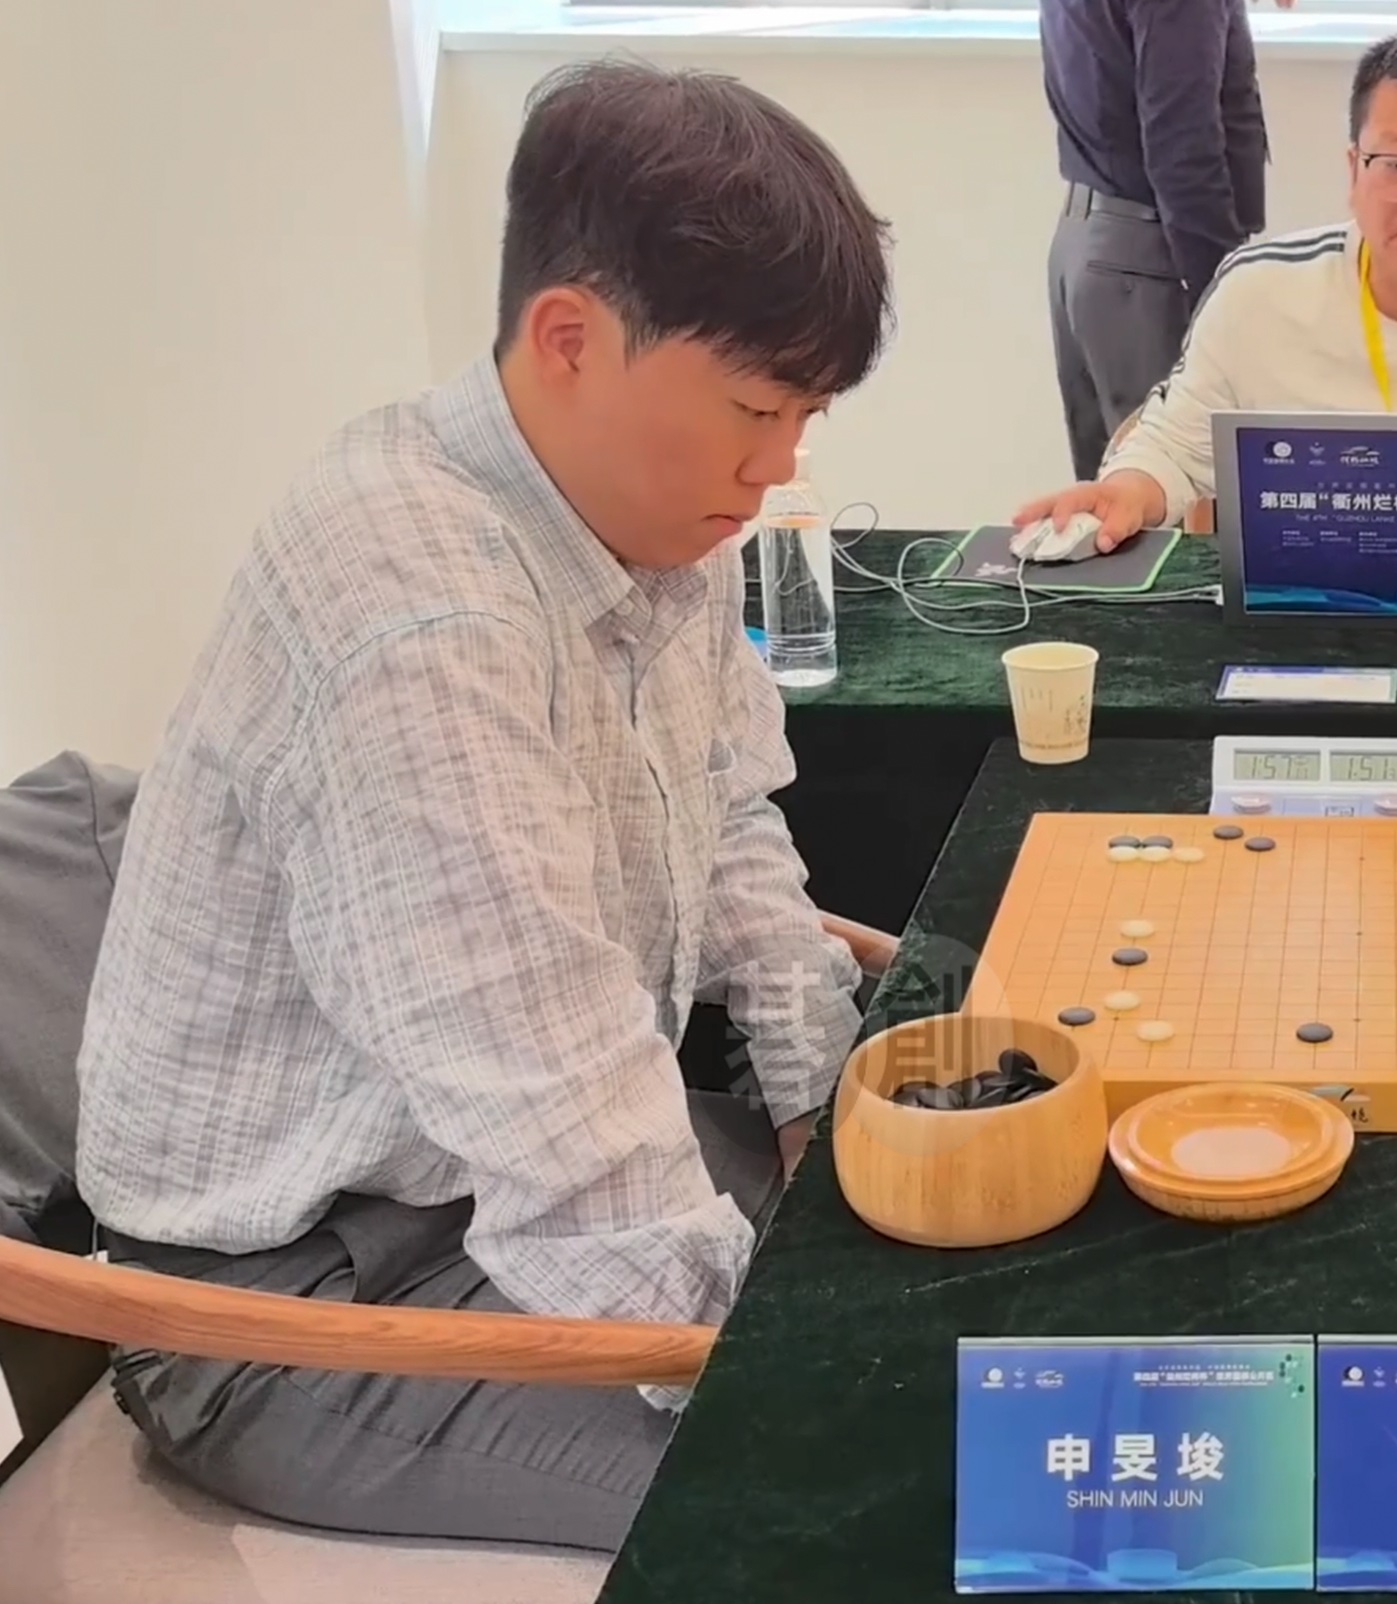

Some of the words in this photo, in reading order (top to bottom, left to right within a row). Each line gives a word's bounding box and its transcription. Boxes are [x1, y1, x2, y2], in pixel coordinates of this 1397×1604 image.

[1046, 1431, 1225, 1482] 申旻埈
[1066, 1489, 1114, 1508] SHIN
[1120, 1489, 1158, 1508] MIN
[1163, 1489, 1204, 1508] JUN
